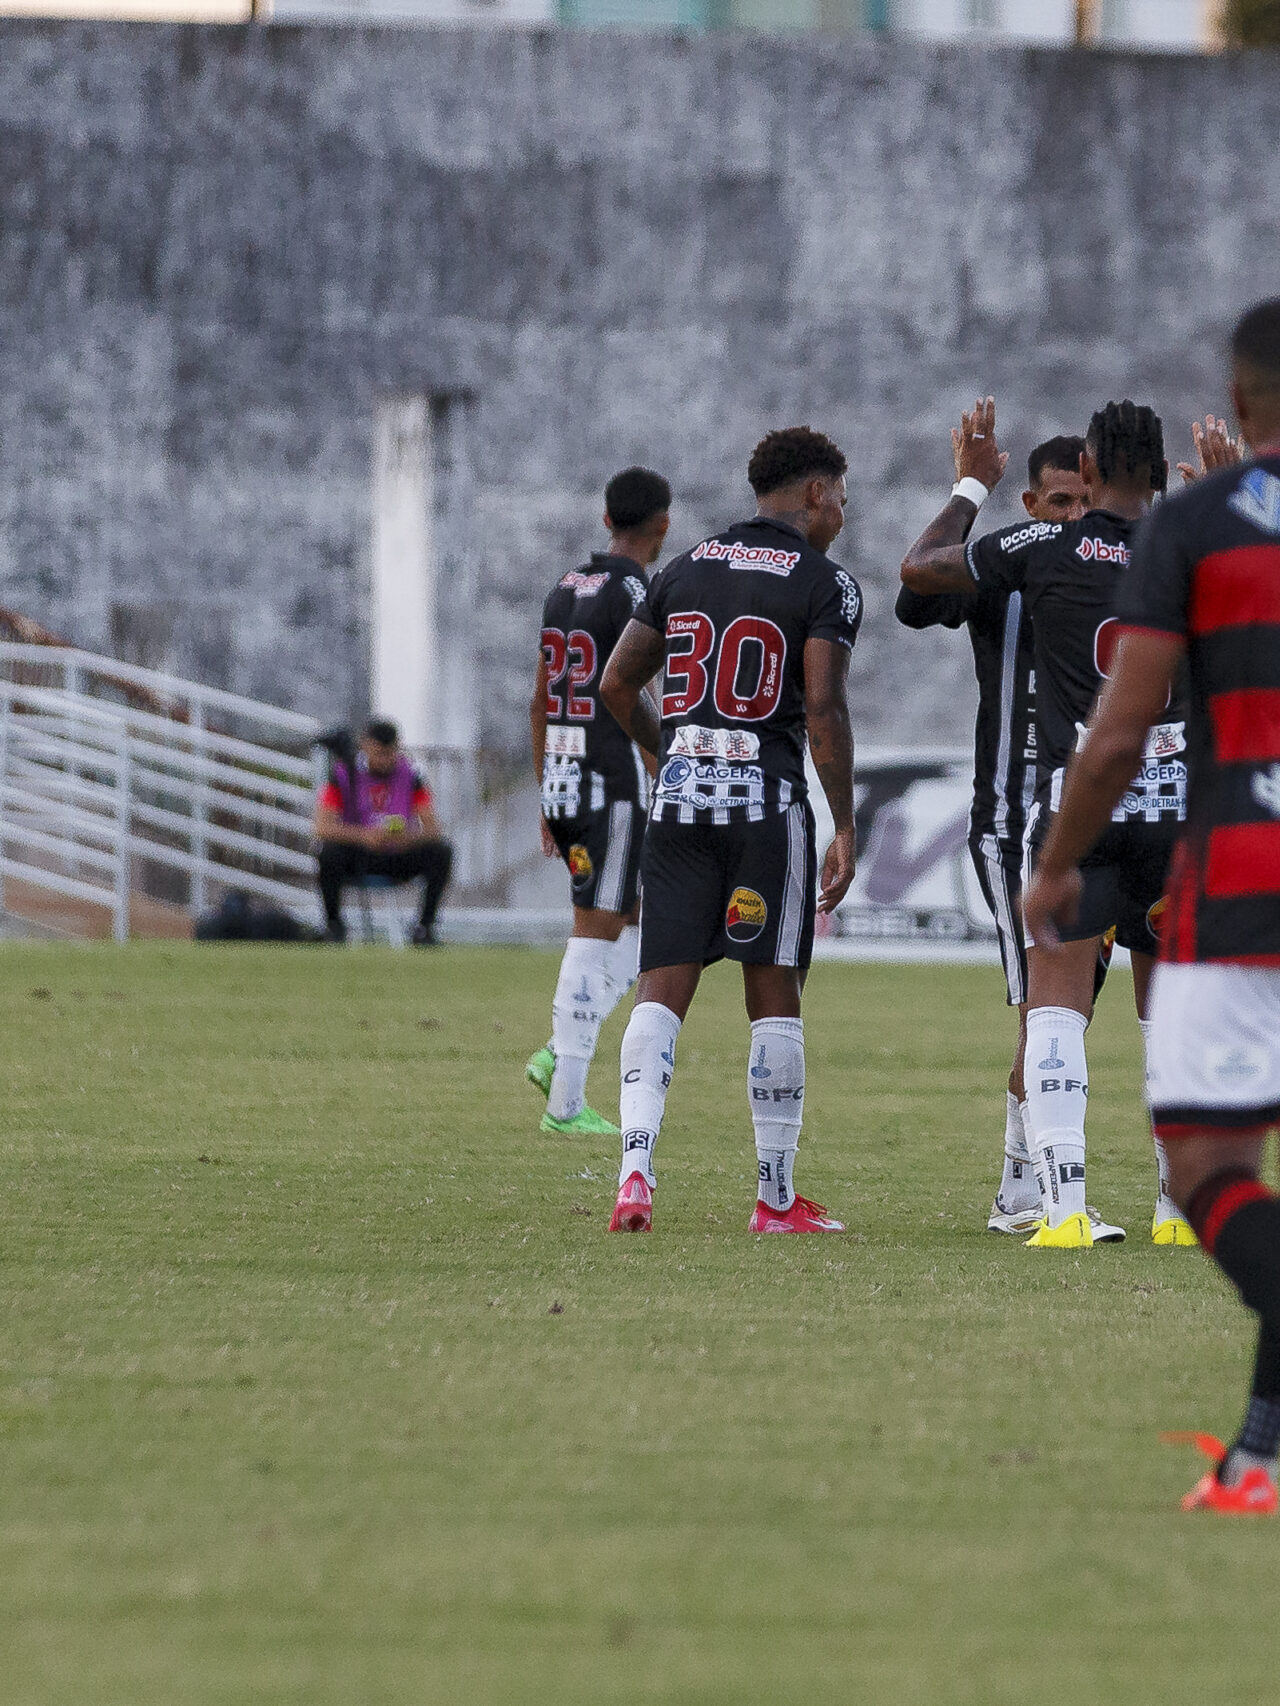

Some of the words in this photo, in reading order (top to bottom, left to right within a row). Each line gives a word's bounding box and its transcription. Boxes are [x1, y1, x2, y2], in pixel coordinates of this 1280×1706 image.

[704, 540, 801, 570] brisanet
[541, 627, 598, 720] 22
[662, 611, 787, 721] 30
[766, 652, 778, 686] Sicredi
[694, 766, 761, 779] CAGEPA
[1138, 766, 1187, 781] AGEPA
